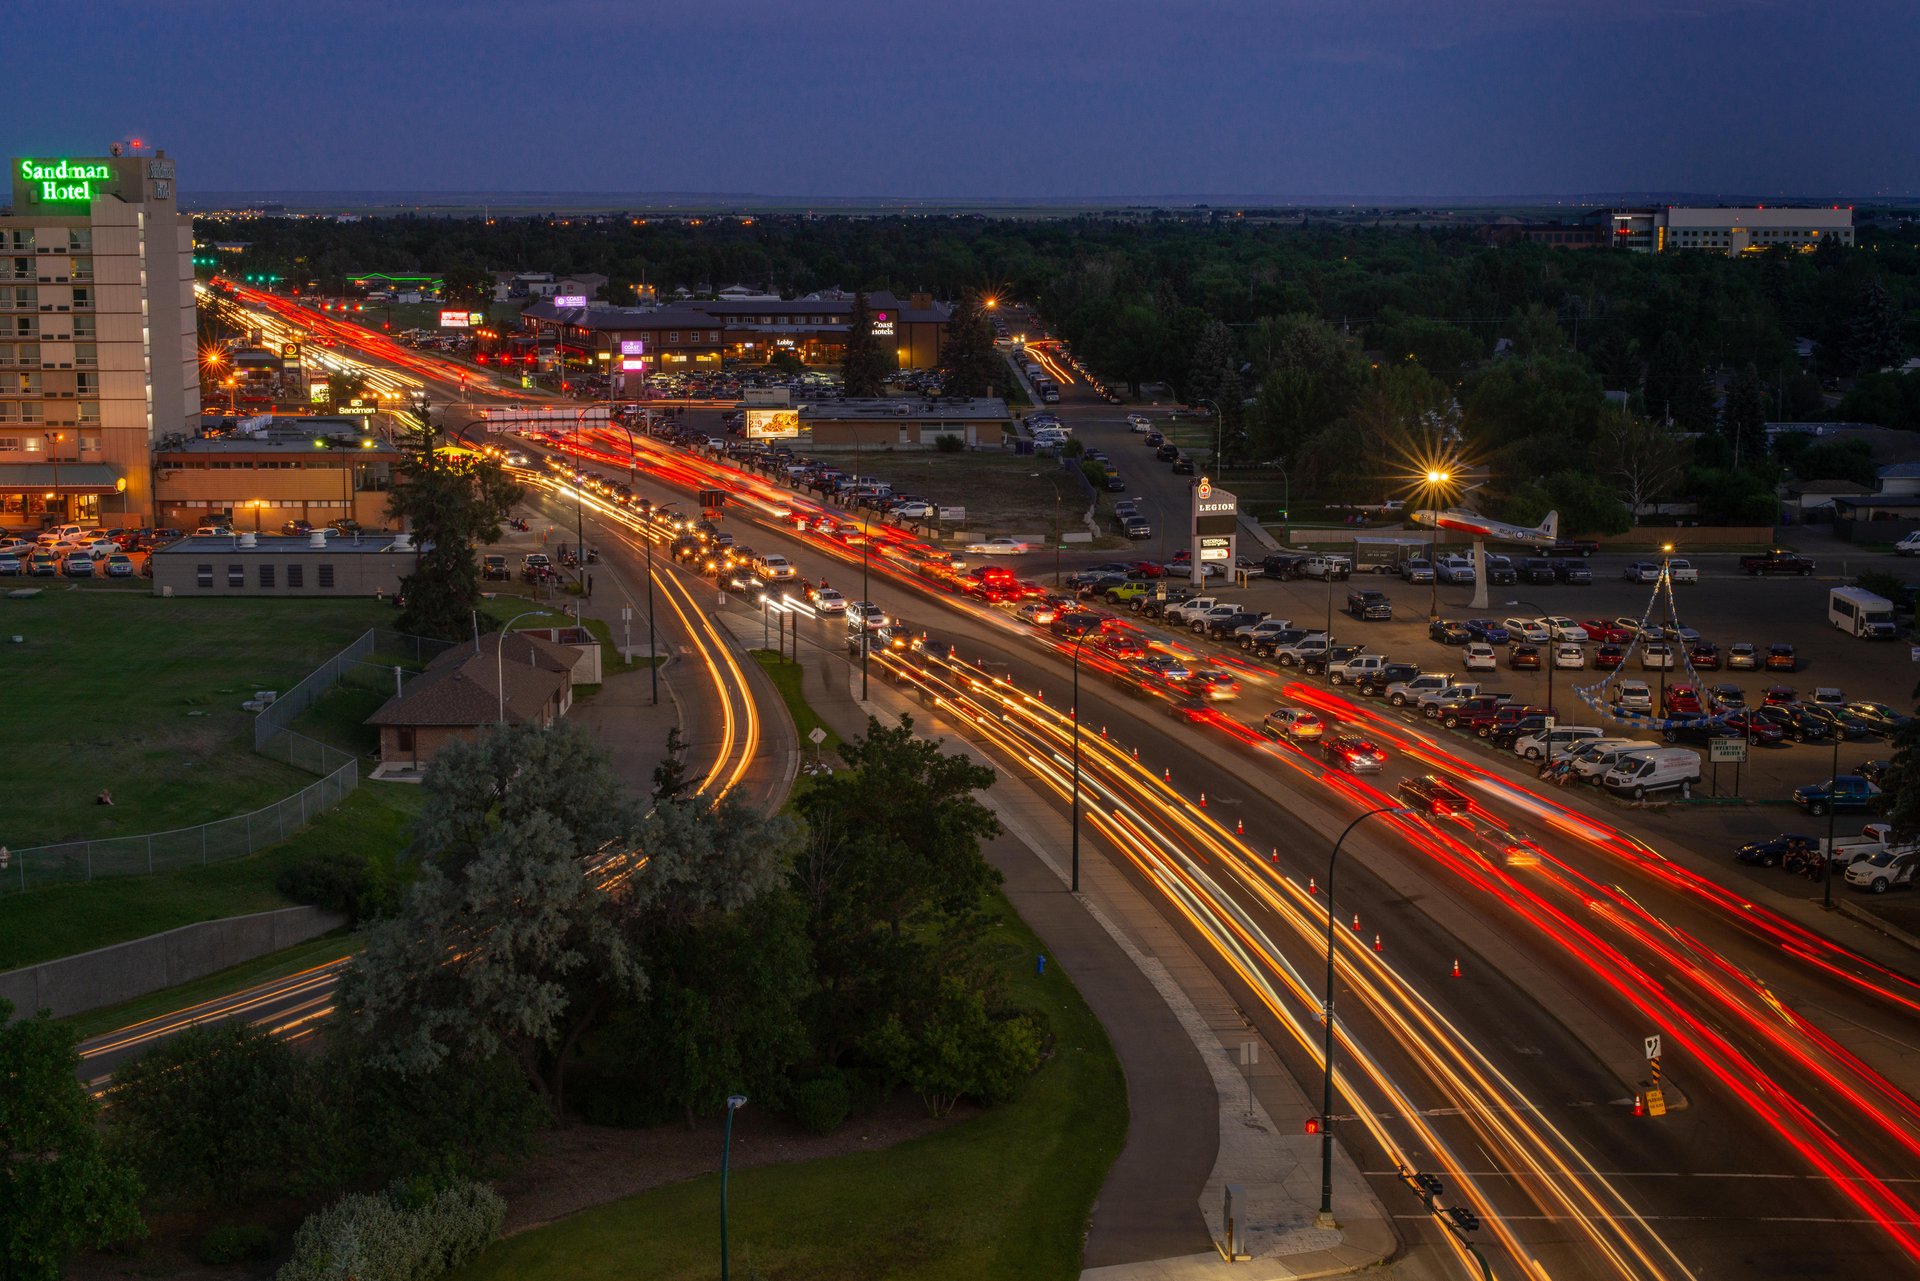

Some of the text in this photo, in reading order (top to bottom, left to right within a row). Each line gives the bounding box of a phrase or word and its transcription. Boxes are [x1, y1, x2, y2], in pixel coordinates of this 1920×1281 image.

[22, 160, 109, 180] Sandman
[43, 181, 91, 200] Hotel
[777, 339, 794, 347] Lobby
[338, 407, 376, 415] Sandman
[1199, 503, 1235, 512] LEGION
